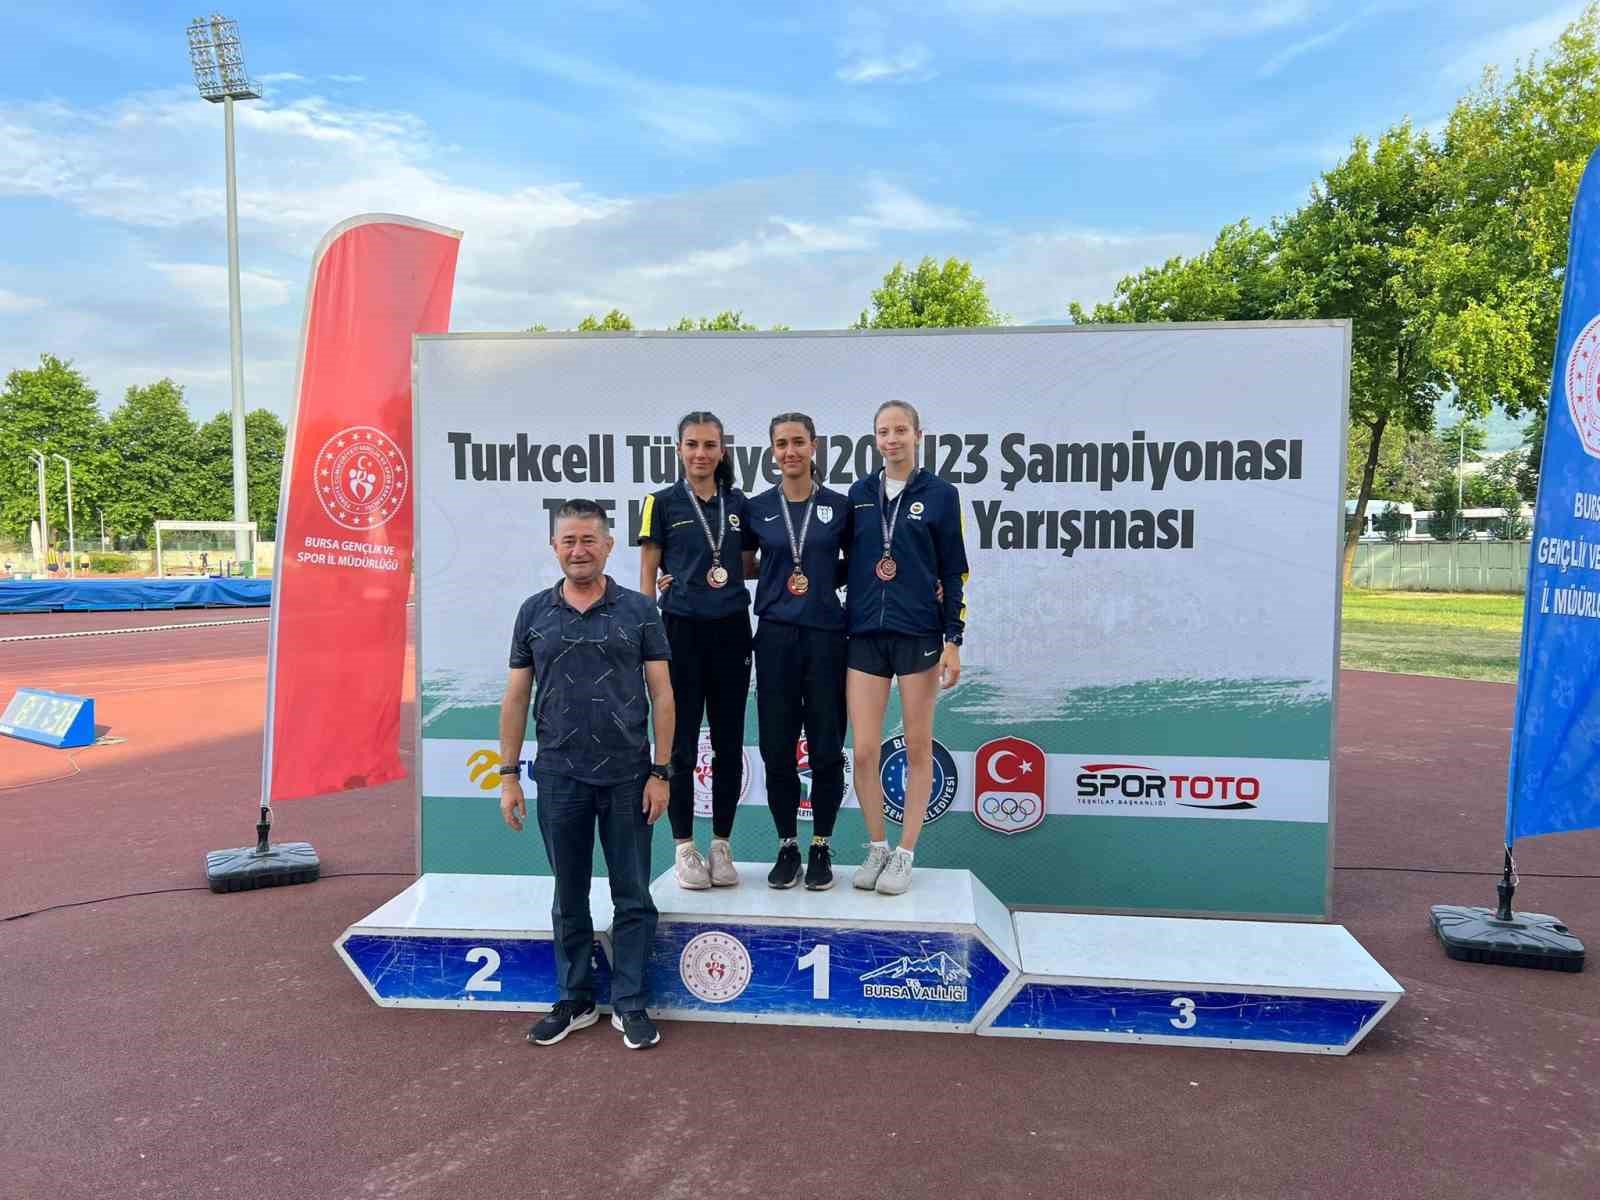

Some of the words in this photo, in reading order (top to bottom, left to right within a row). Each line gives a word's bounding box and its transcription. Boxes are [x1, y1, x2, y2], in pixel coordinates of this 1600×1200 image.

[448, 431, 614, 484] Turkcell
[626, 434, 784, 492] Tüye
[1001, 431, 1302, 491] Şampiyonası
[304, 536, 340, 550] BURSA
[383, 545, 396, 556] VE
[972, 500, 1194, 557] Yarışması
[297, 552, 326, 565] SPOR
[338, 555, 400, 571] MÜDÜRLÜĞÜ
[464, 946, 502, 993] 2
[797, 944, 830, 1000] 1
[863, 984, 910, 999] BURSA
[911, 984, 968, 1001] VALİLİĞİ
[1169, 997, 1197, 1030] 3
